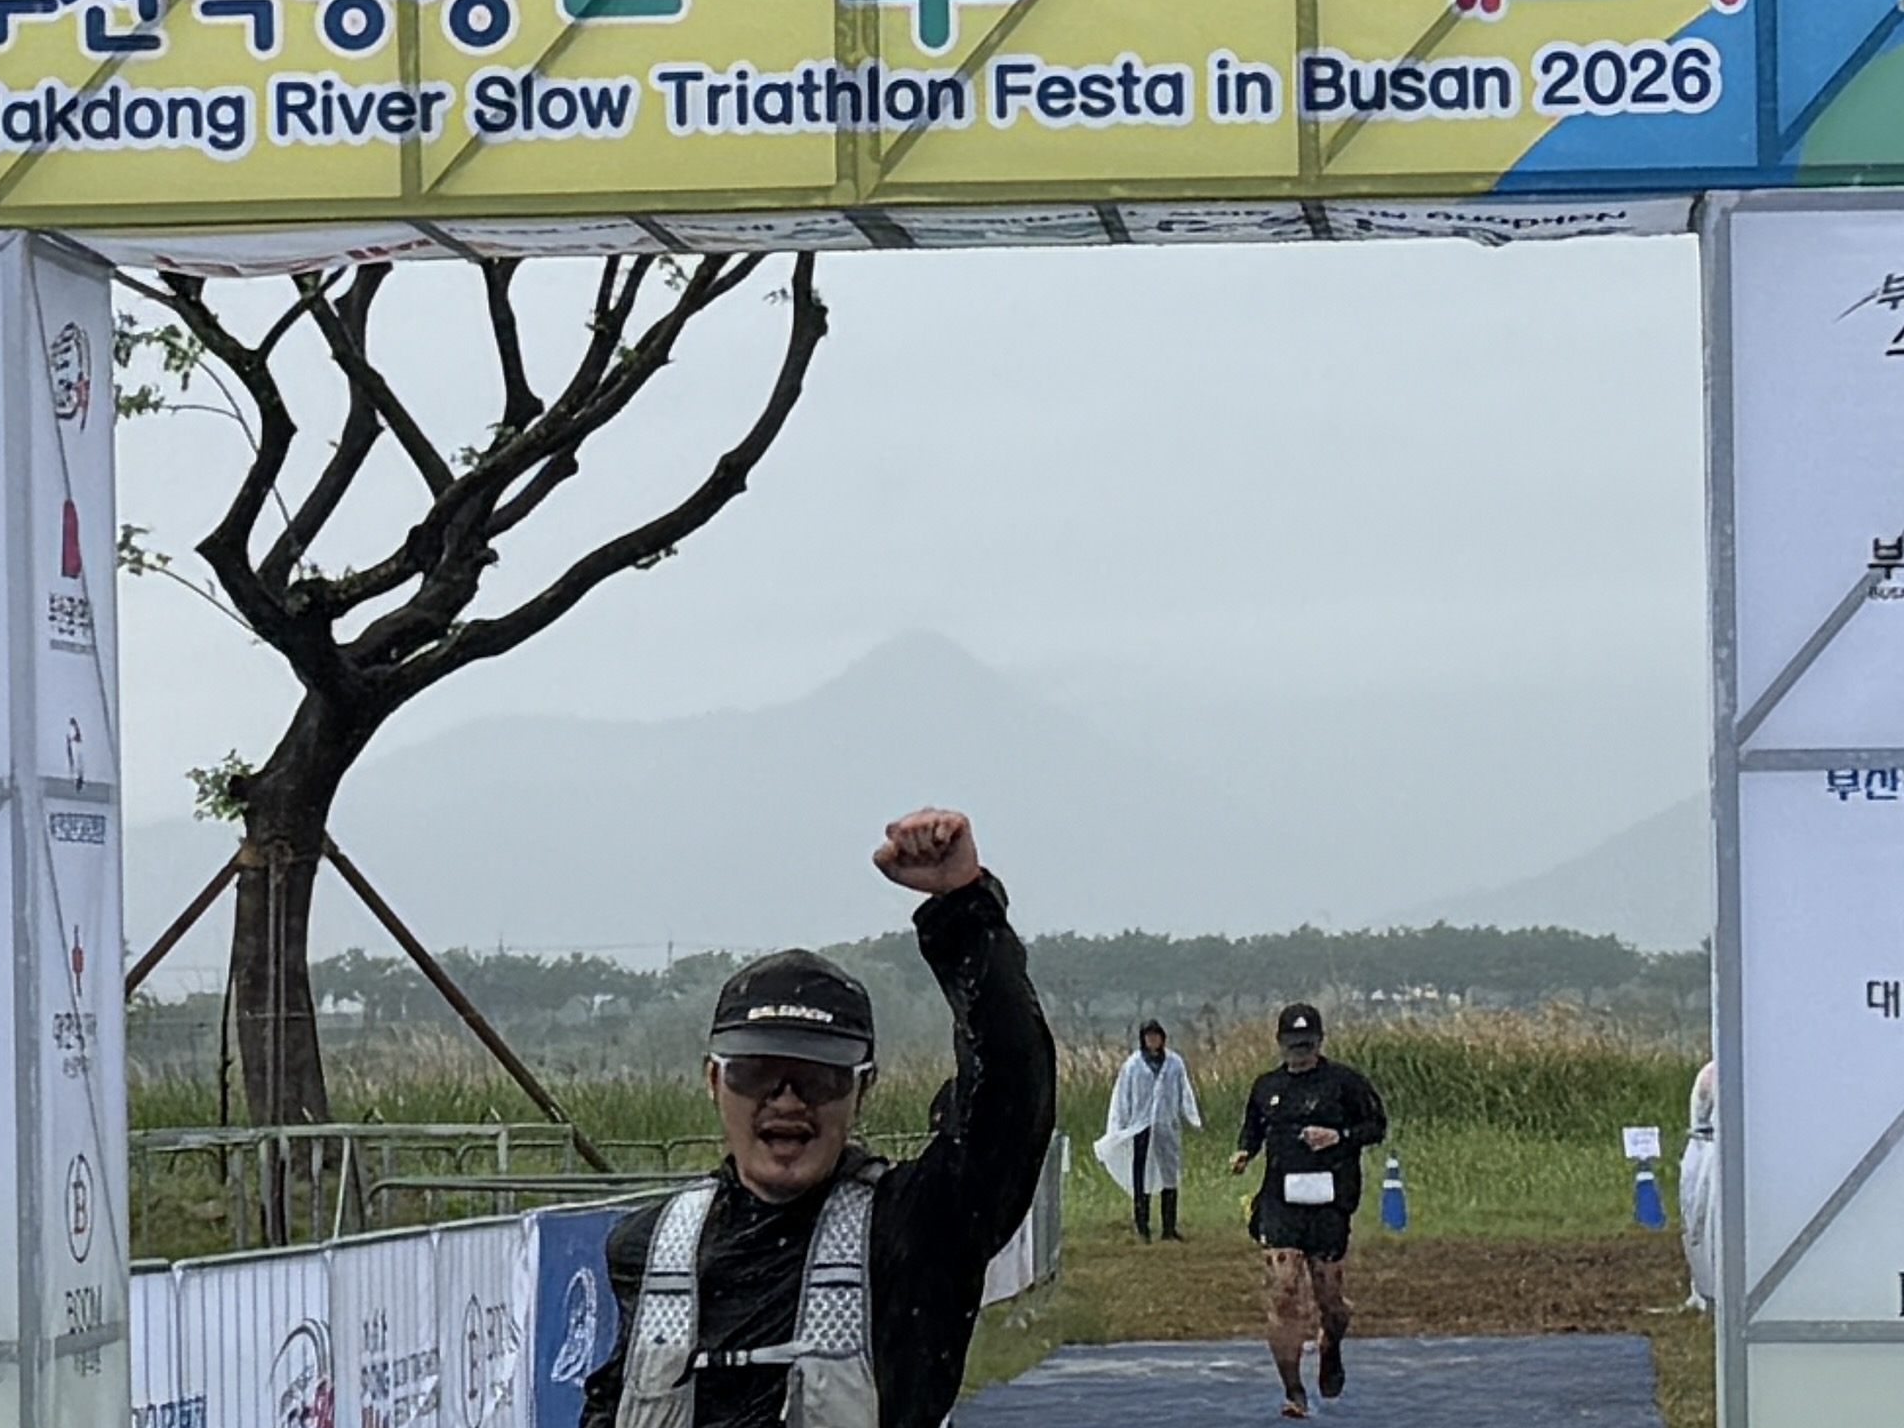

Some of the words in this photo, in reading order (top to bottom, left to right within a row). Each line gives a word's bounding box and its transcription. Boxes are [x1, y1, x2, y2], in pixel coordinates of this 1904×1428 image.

[276, 81, 444, 136] River
[473, 74, 628, 134] Slow
[659, 62, 964, 132] Triathlon
[995, 58, 1185, 122] Festa
[1218, 56, 1274, 114] in
[1302, 56, 1511, 112] Busan
[1542, 50, 1712, 108] 2026
